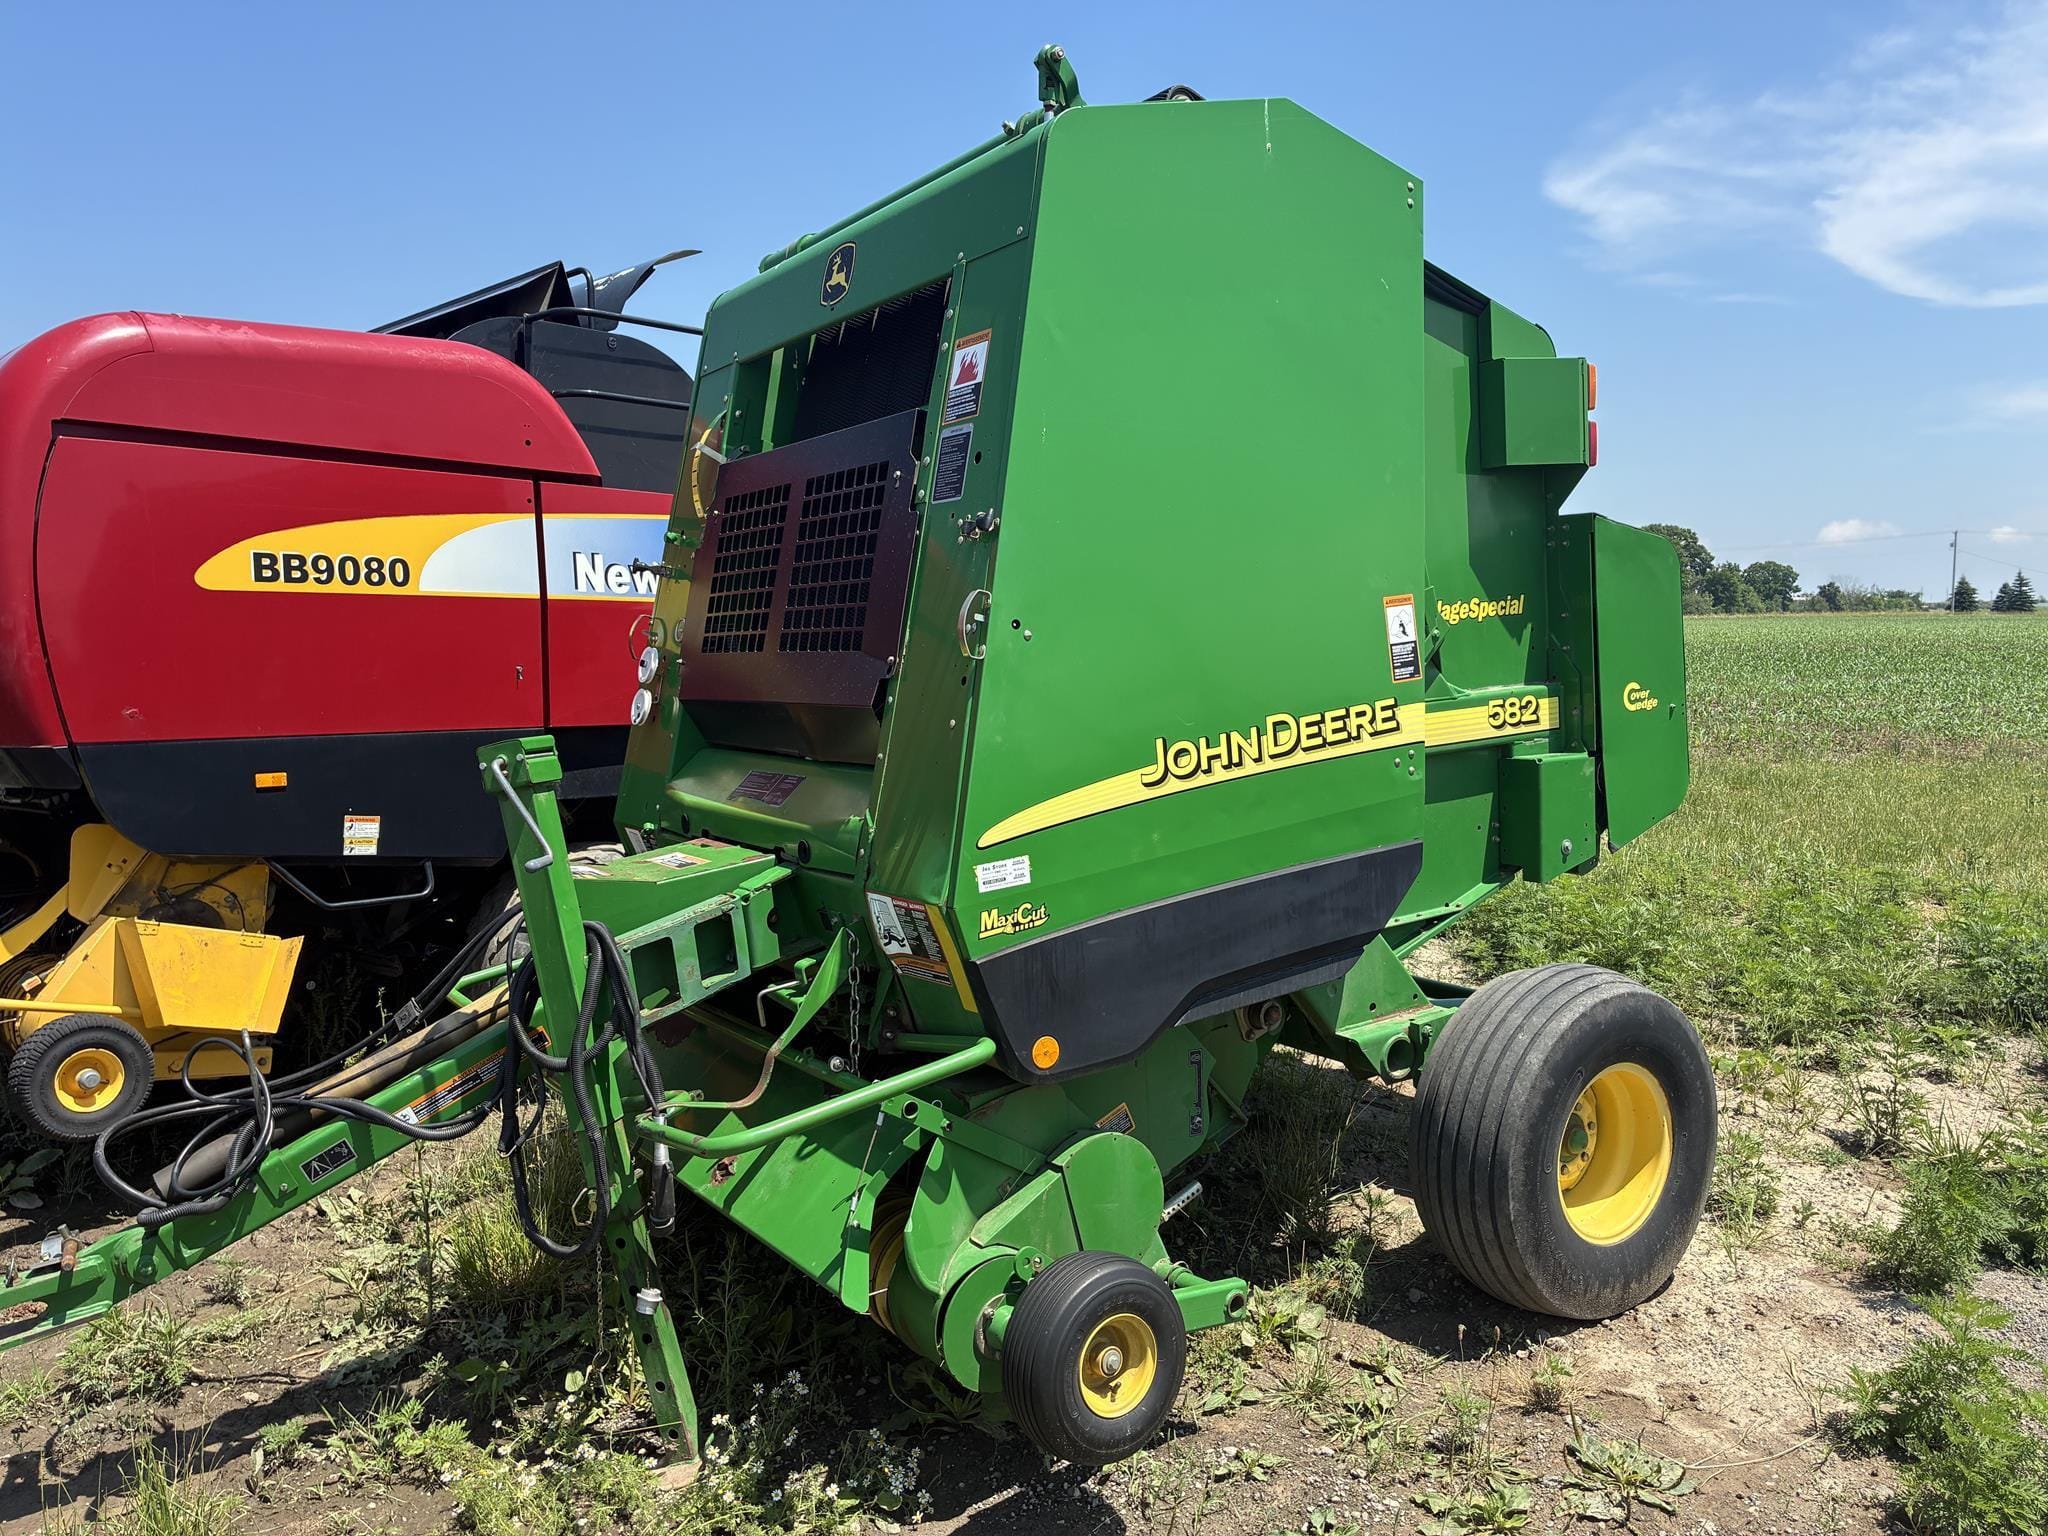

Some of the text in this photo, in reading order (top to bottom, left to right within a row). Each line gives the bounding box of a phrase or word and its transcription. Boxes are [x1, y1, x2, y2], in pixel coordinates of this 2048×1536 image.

[250, 549, 411, 588] BB9080
[572, 551, 660, 595] New
[1487, 695, 1540, 729] 582
[1140, 696, 1401, 789] JOHN DEERE
[979, 901, 1048, 933] MaxiCut
